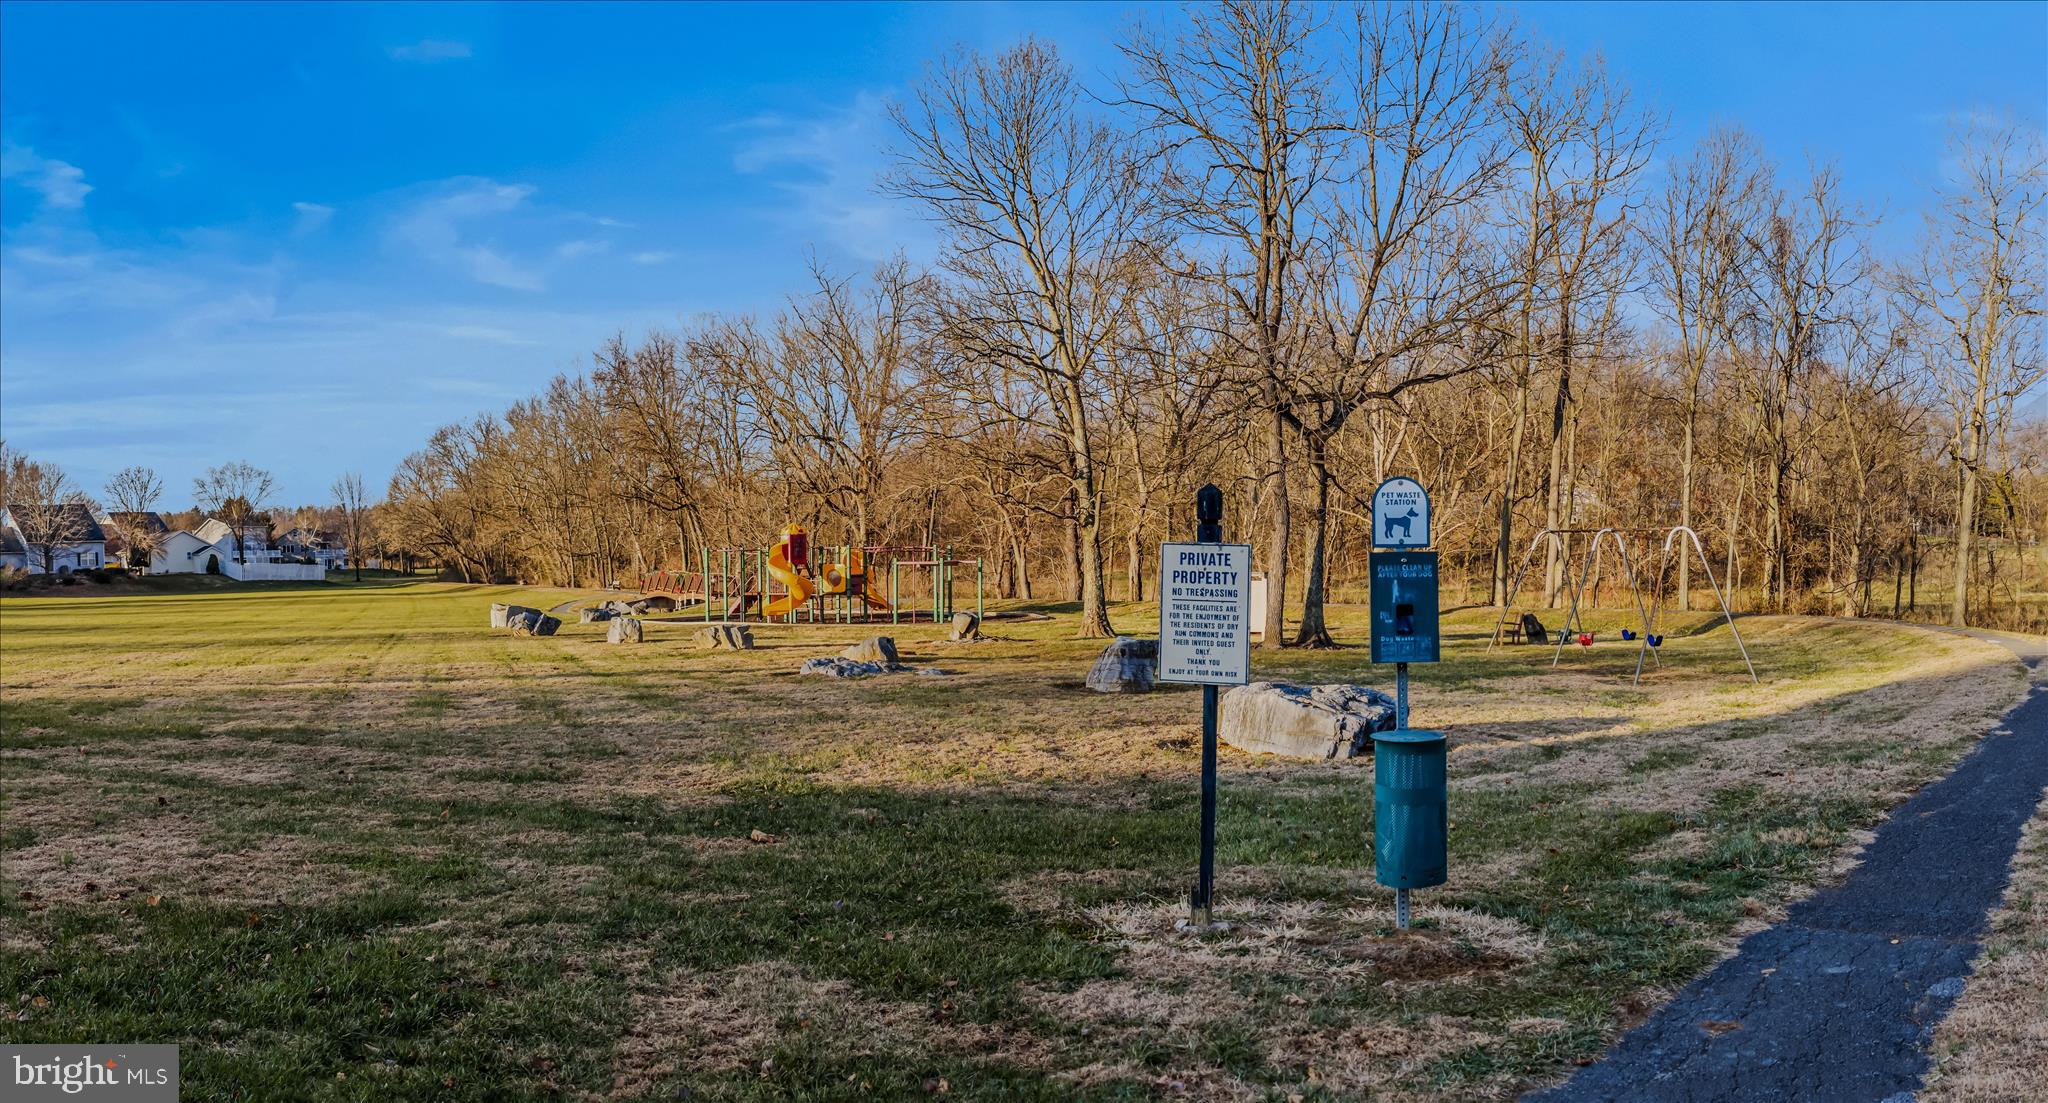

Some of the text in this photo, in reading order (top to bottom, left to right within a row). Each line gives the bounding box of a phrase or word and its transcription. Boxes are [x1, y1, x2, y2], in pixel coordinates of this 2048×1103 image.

[1180, 552, 1231, 567] PRIVATE
[1173, 571, 1238, 585] PROPERTY
[1172, 588, 1238, 598] NO TRESPASSING
